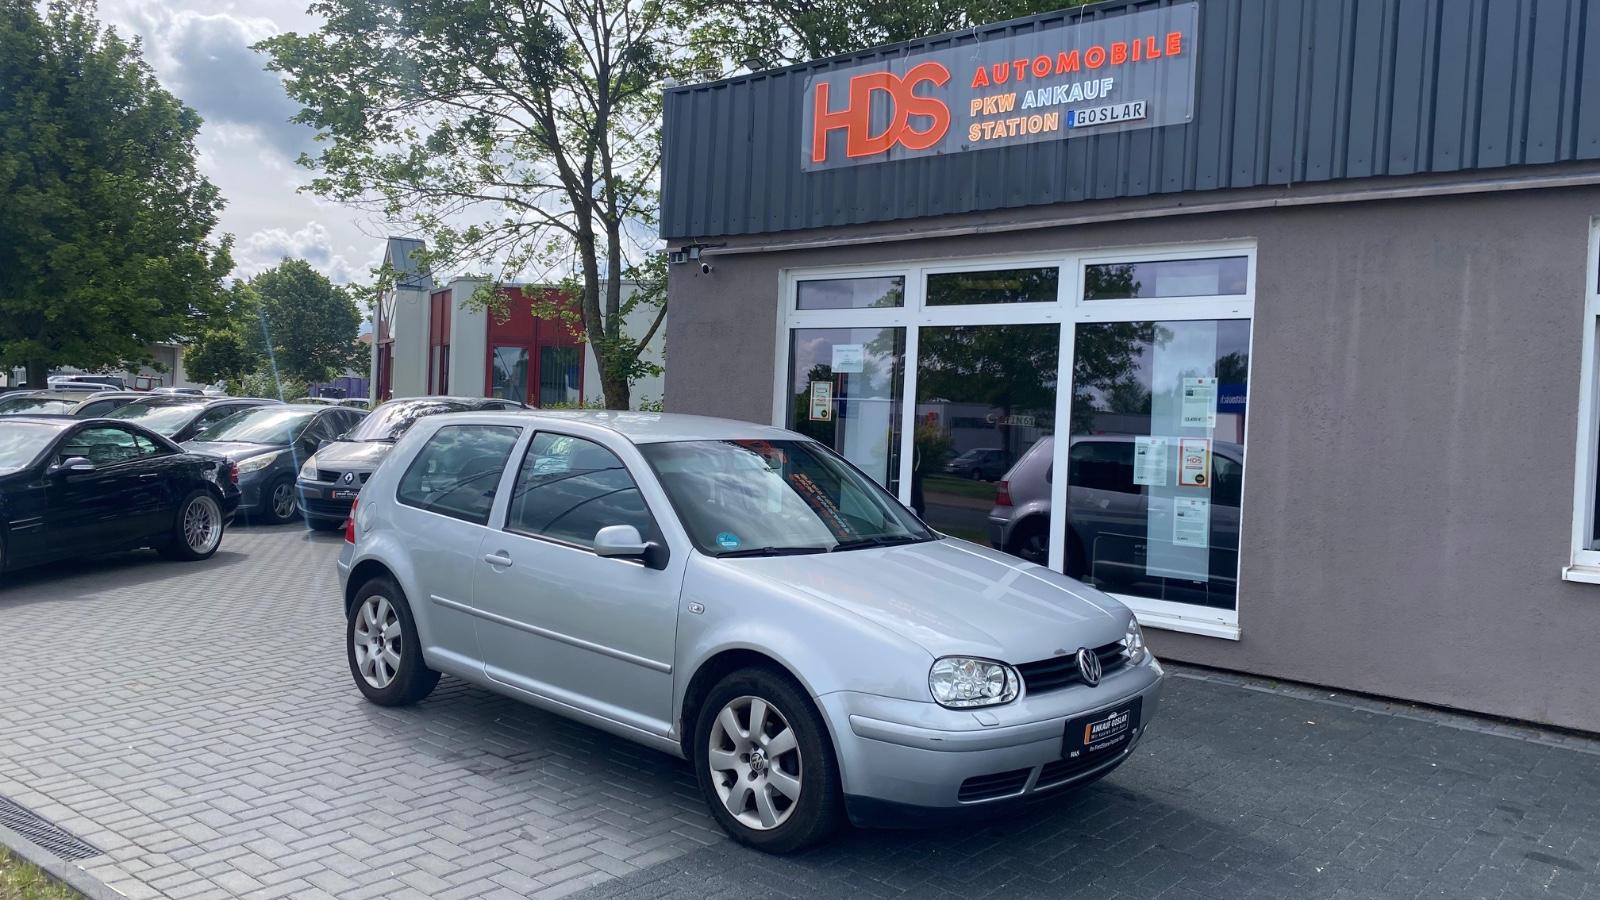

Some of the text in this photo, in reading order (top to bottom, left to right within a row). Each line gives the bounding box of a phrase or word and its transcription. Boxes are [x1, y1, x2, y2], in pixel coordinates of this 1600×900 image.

[972, 32, 1182, 88] AUTOMOBILE
[812, 62, 951, 163] HDS
[970, 77, 1114, 117] PKW ANKAUF
[968, 103, 1142, 142] STATION GOSLAR
